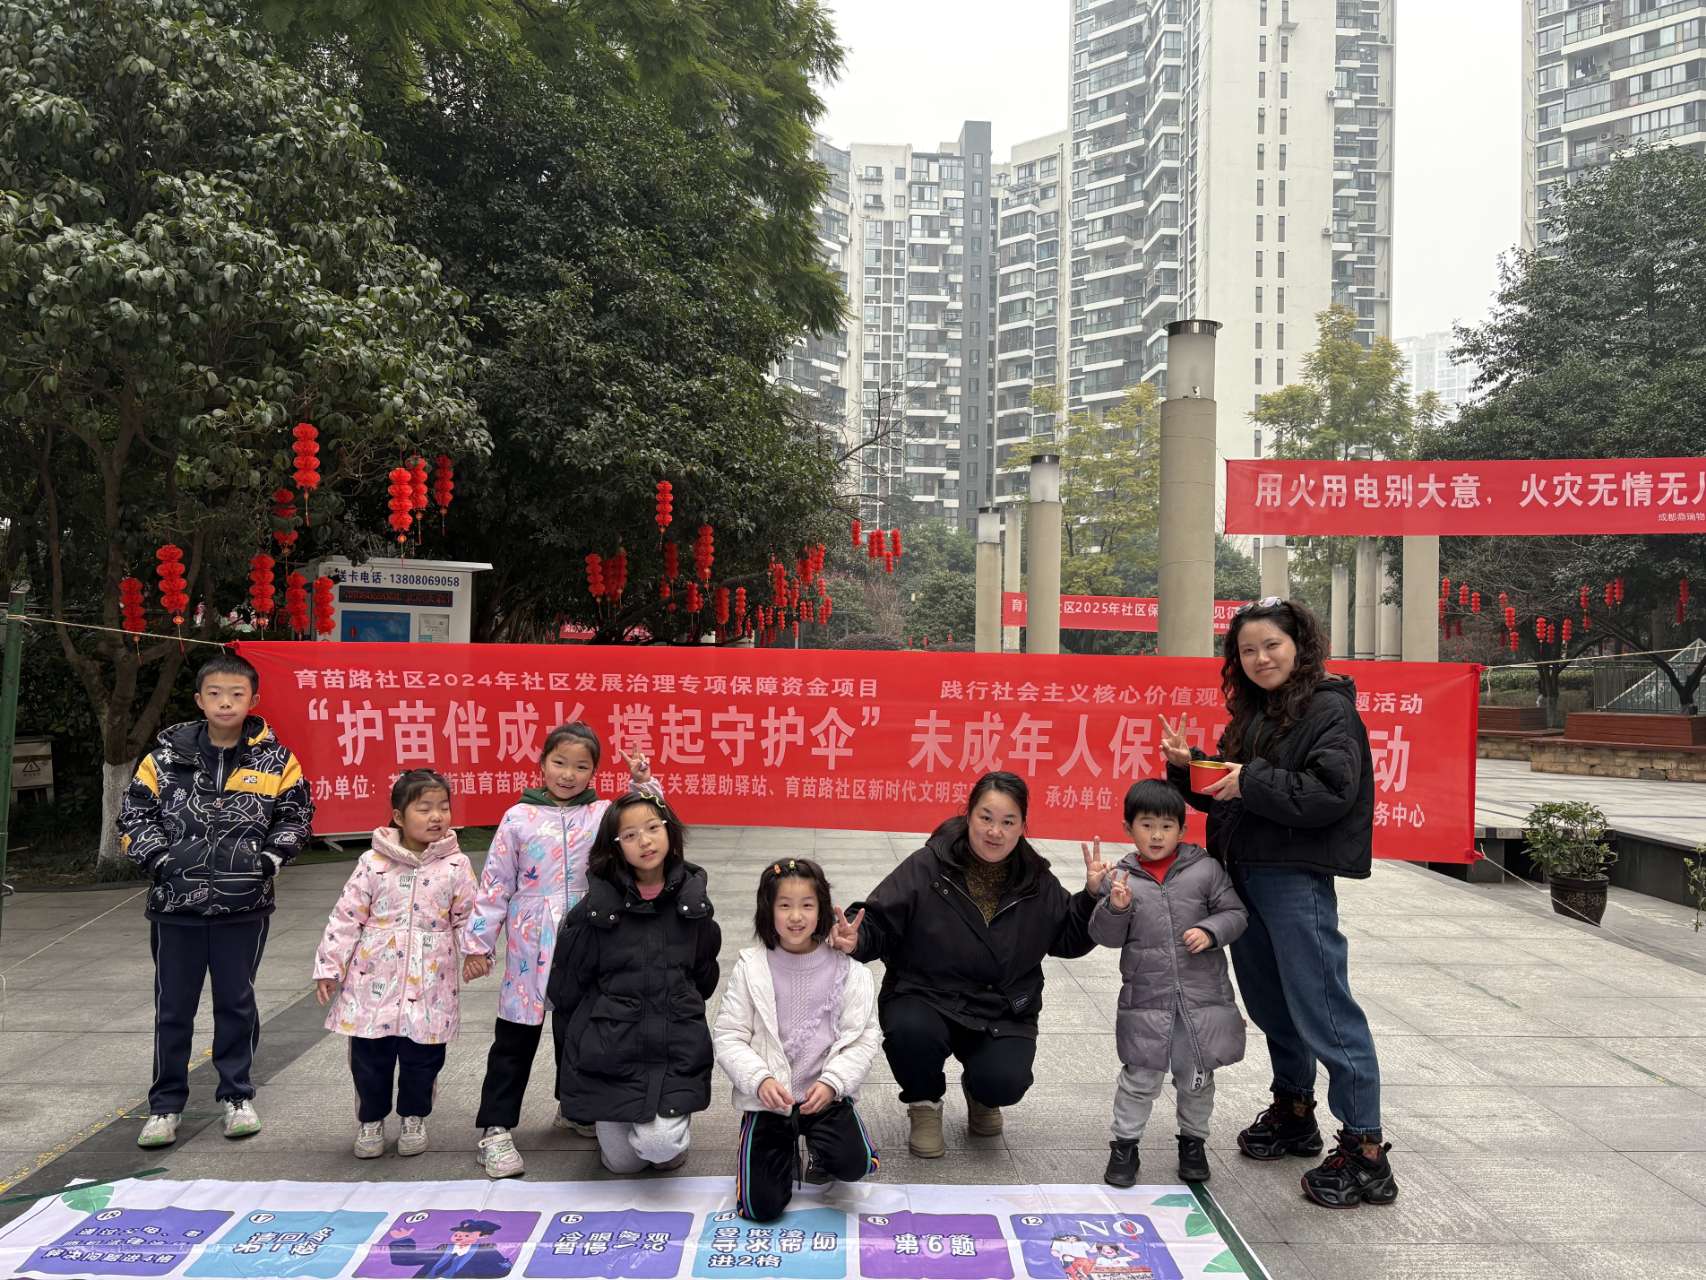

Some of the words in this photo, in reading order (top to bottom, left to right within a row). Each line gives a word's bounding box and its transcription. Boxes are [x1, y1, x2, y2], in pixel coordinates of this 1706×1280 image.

[293, 669, 878, 698] 育苗路社区2024年社区发展治理专项保障资金项目
[1077, 1219, 1144, 1236] NO
[894, 1233, 978, 1257] 第6题
[708, 1253, 782, 1268] 进2格
